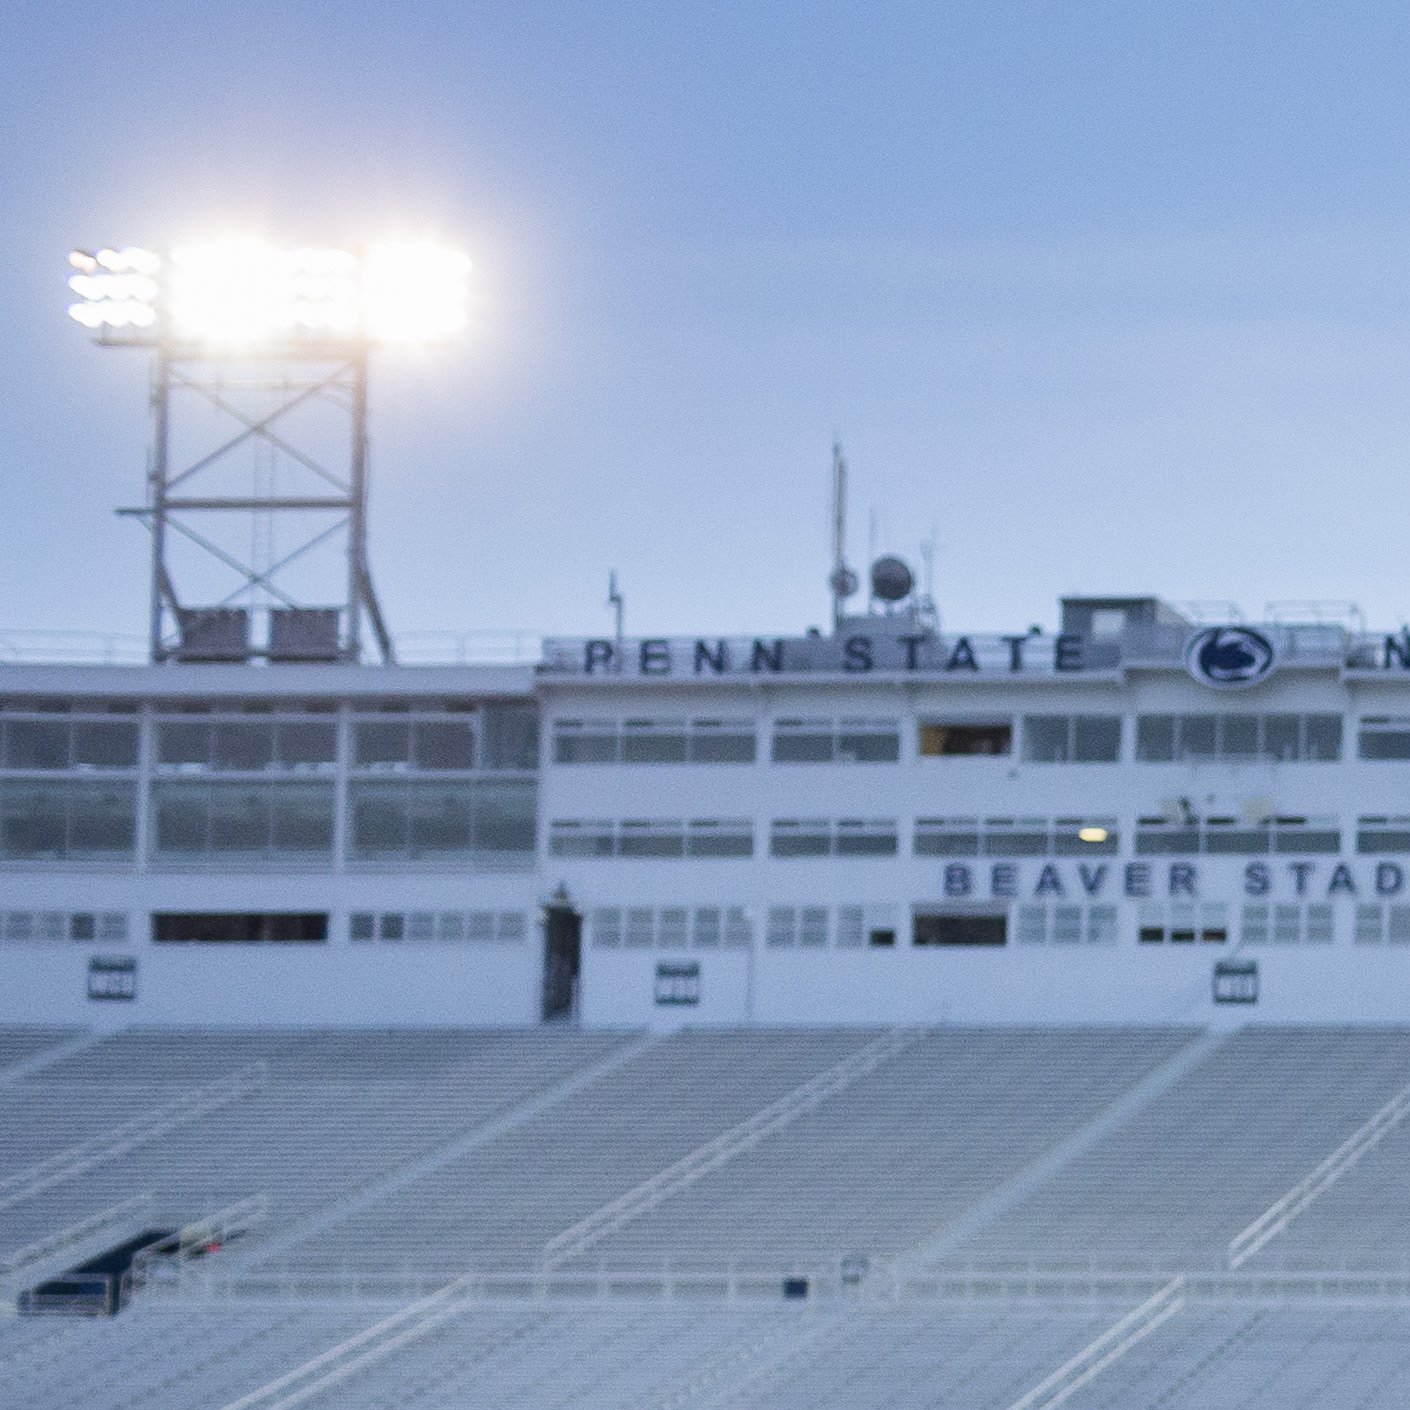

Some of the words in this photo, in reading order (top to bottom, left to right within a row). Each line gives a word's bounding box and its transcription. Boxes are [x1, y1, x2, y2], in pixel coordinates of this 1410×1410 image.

[584, 637, 785, 674] PENN
[842, 634, 1083, 672] STATE
[943, 862, 1197, 897] BEAVER
